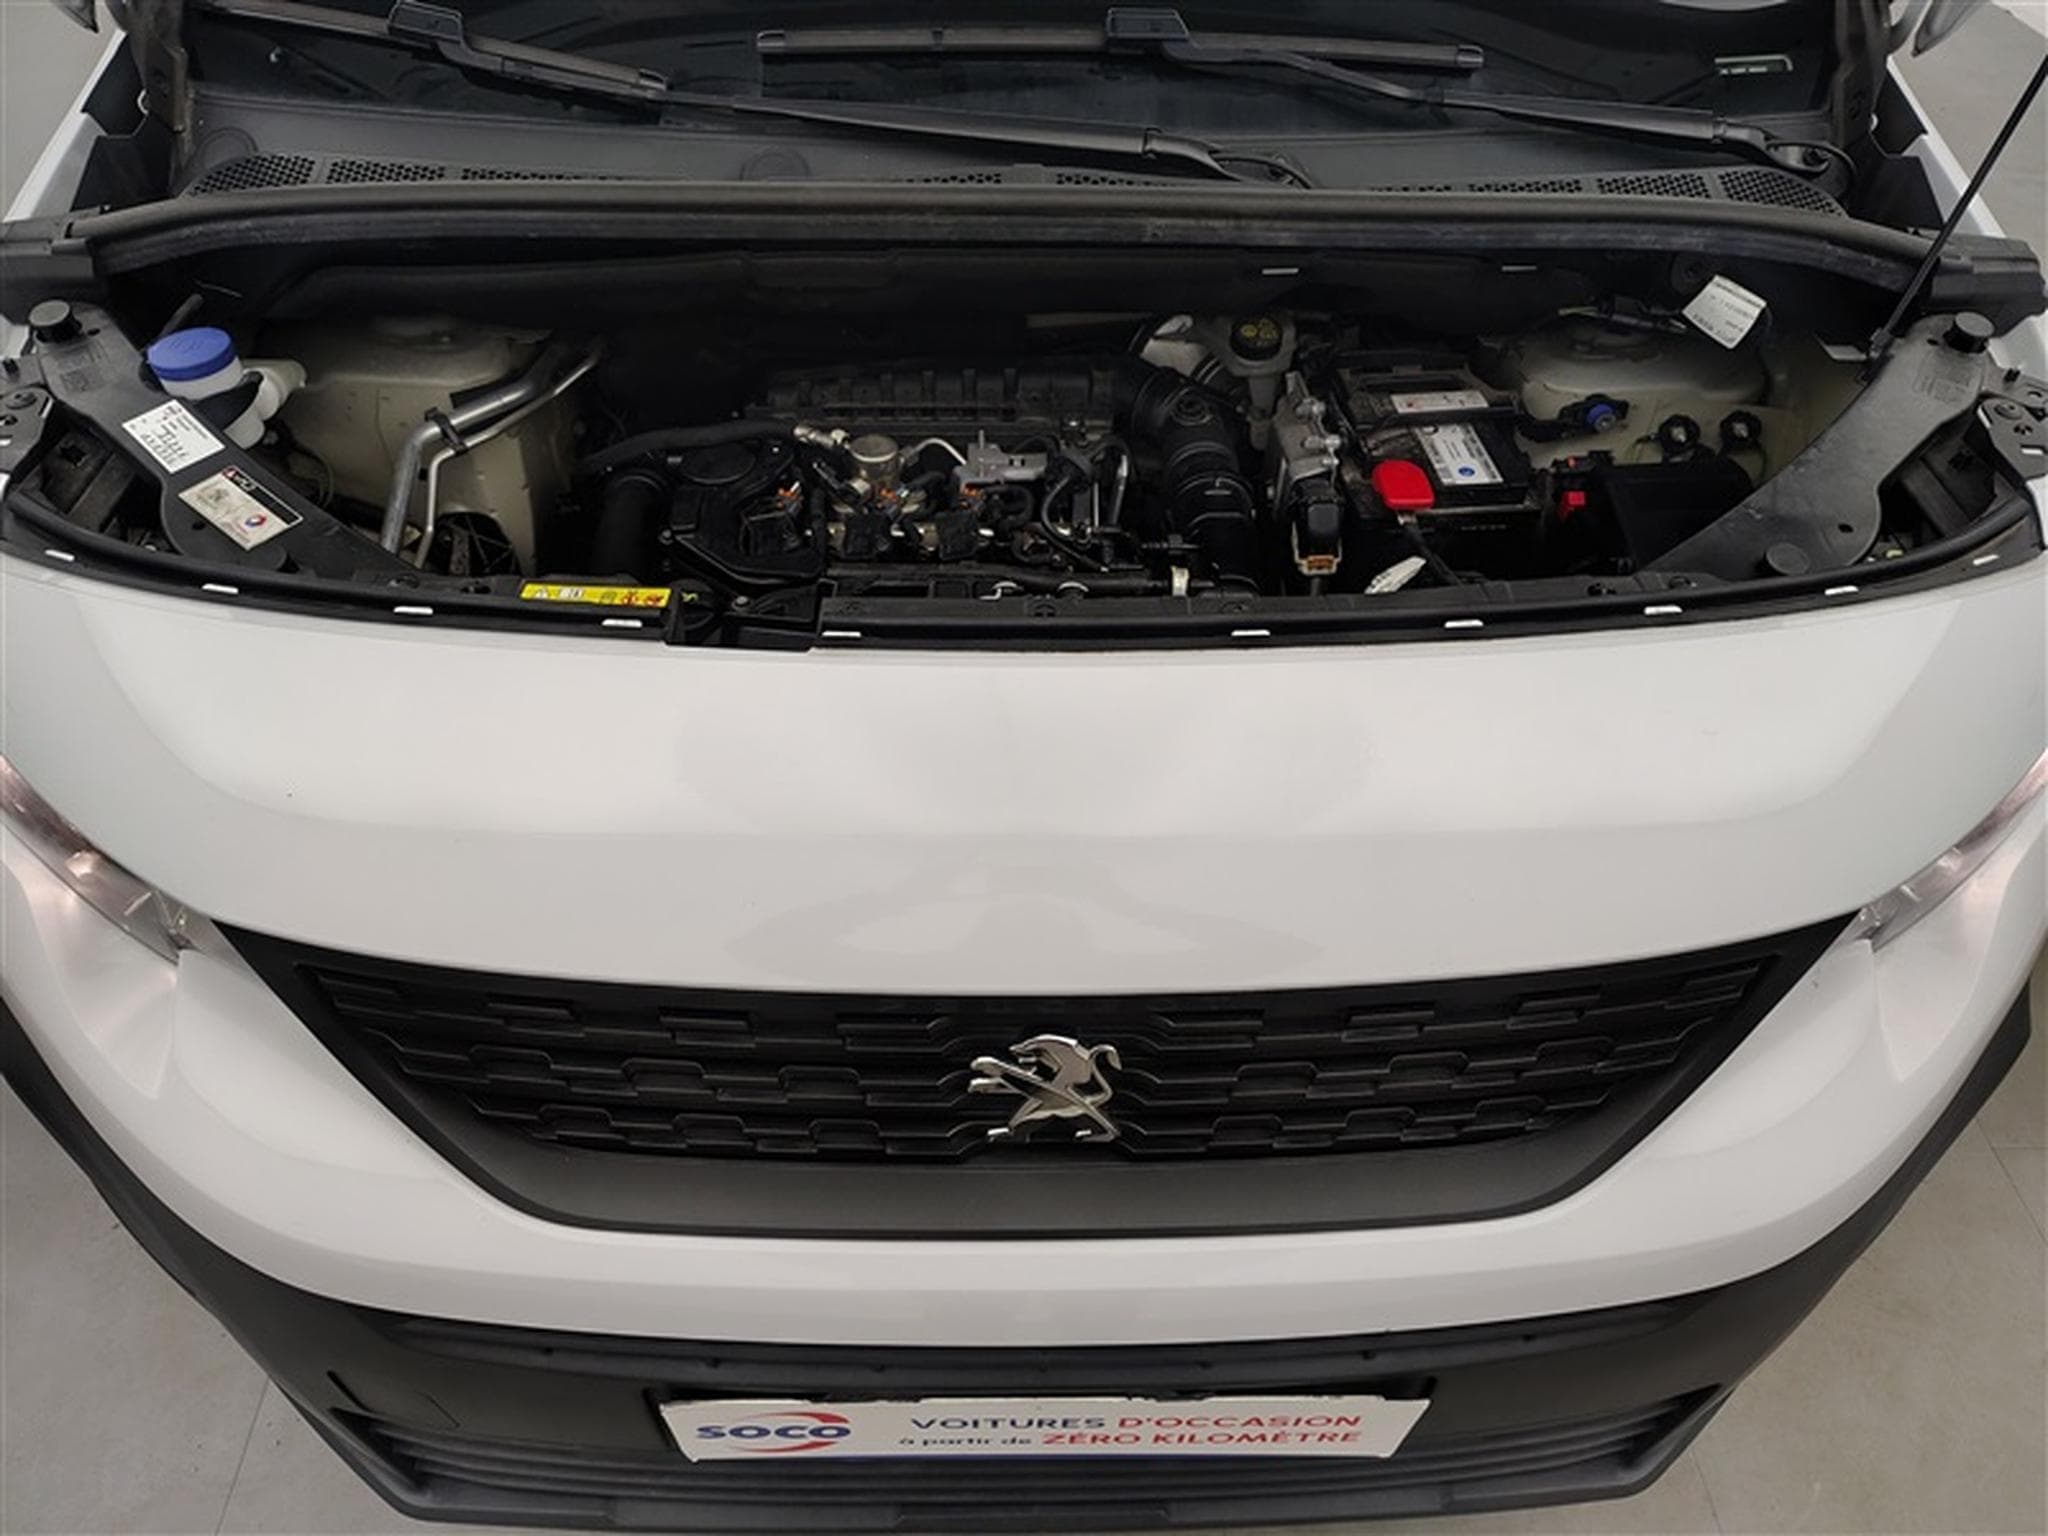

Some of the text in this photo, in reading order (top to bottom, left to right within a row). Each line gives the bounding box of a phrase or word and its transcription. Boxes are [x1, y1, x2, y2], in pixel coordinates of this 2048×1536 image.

[911, 1415, 1362, 1429] VOITURES D'OCCASION
[696, 1425, 851, 1439] SOCO
[1001, 1436, 1032, 1445] de
[1042, 1432, 1142, 1445] ZÉRO
